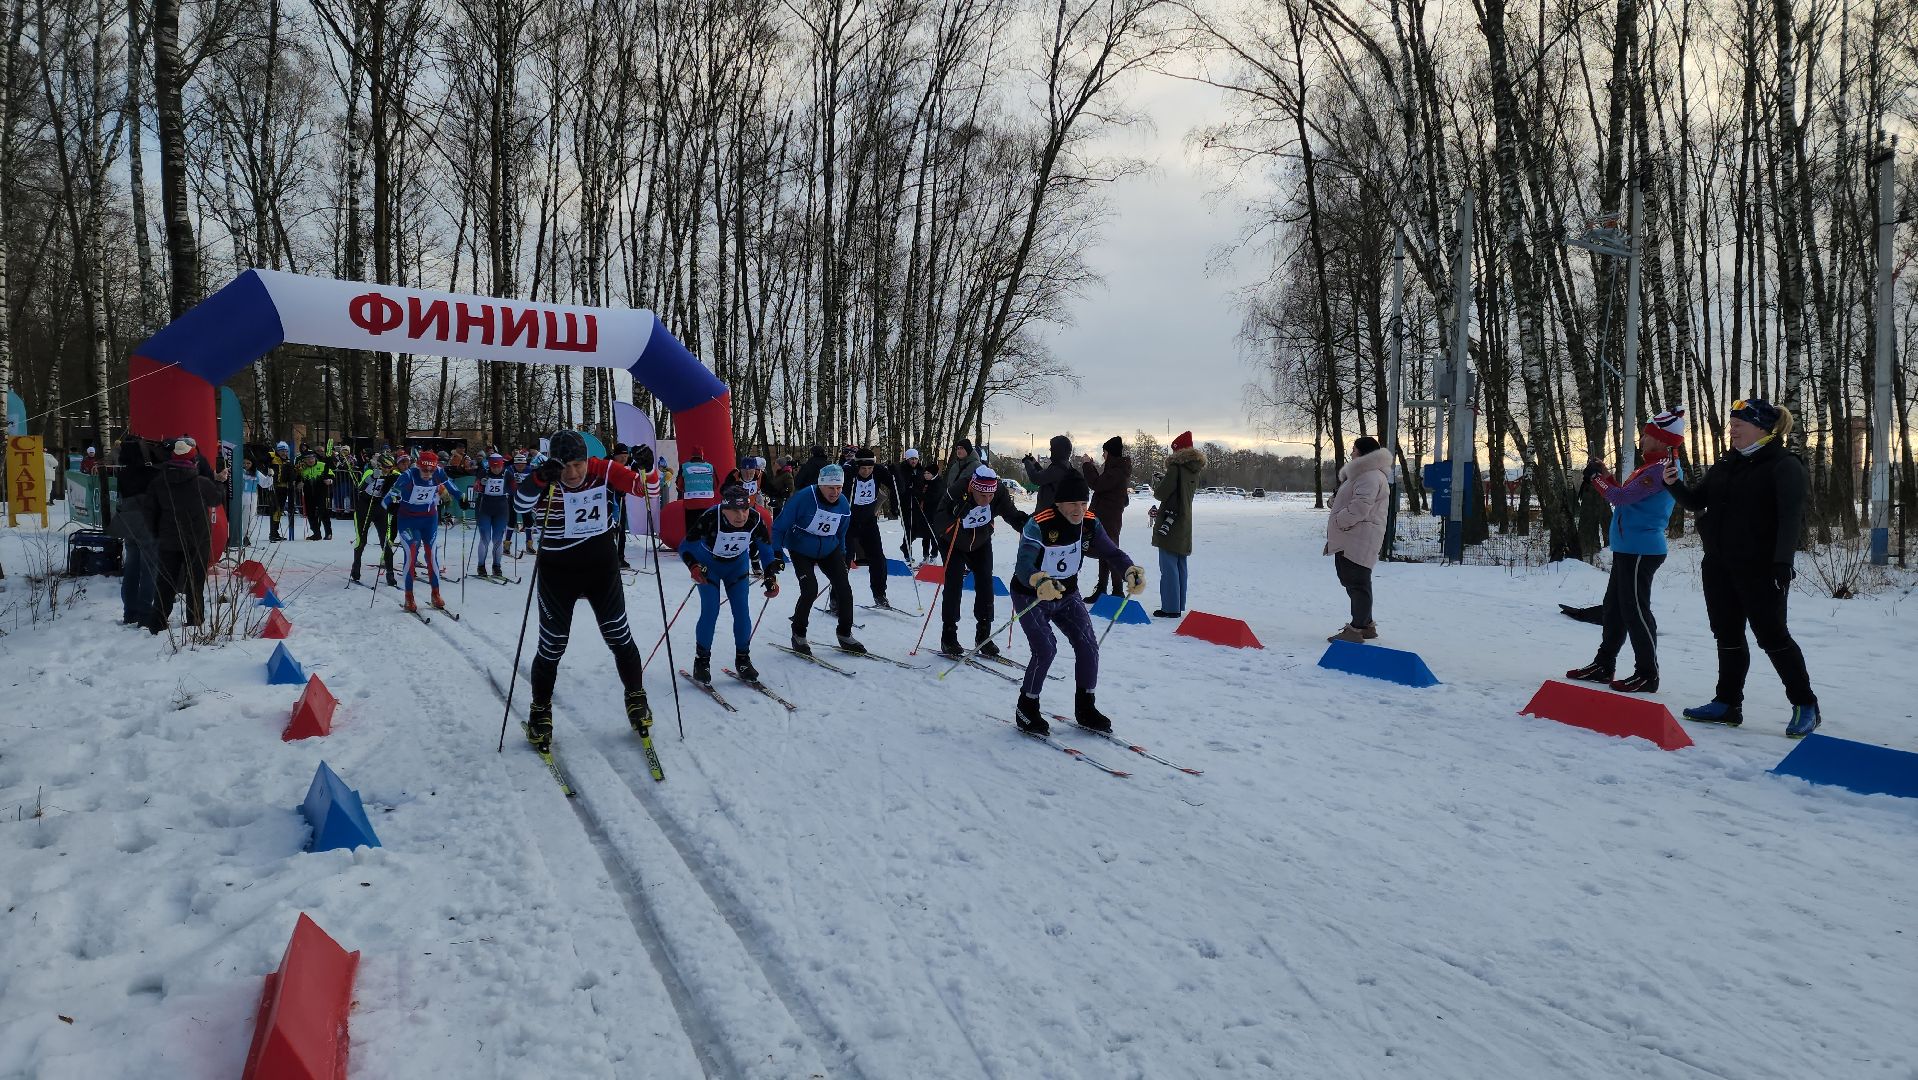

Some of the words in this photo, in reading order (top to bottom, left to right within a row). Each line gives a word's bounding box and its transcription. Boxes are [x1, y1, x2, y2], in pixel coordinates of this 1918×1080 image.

[349, 292, 597, 352] ФИНИШ
[11, 436, 36, 512] СТАРТ
[860, 490, 873, 498] 22
[575, 506, 600, 523] 24
[968, 515, 986, 524] 20
[818, 522, 830, 532] 18
[724, 543, 739, 551] 16
[1057, 558, 1067, 572] 6
